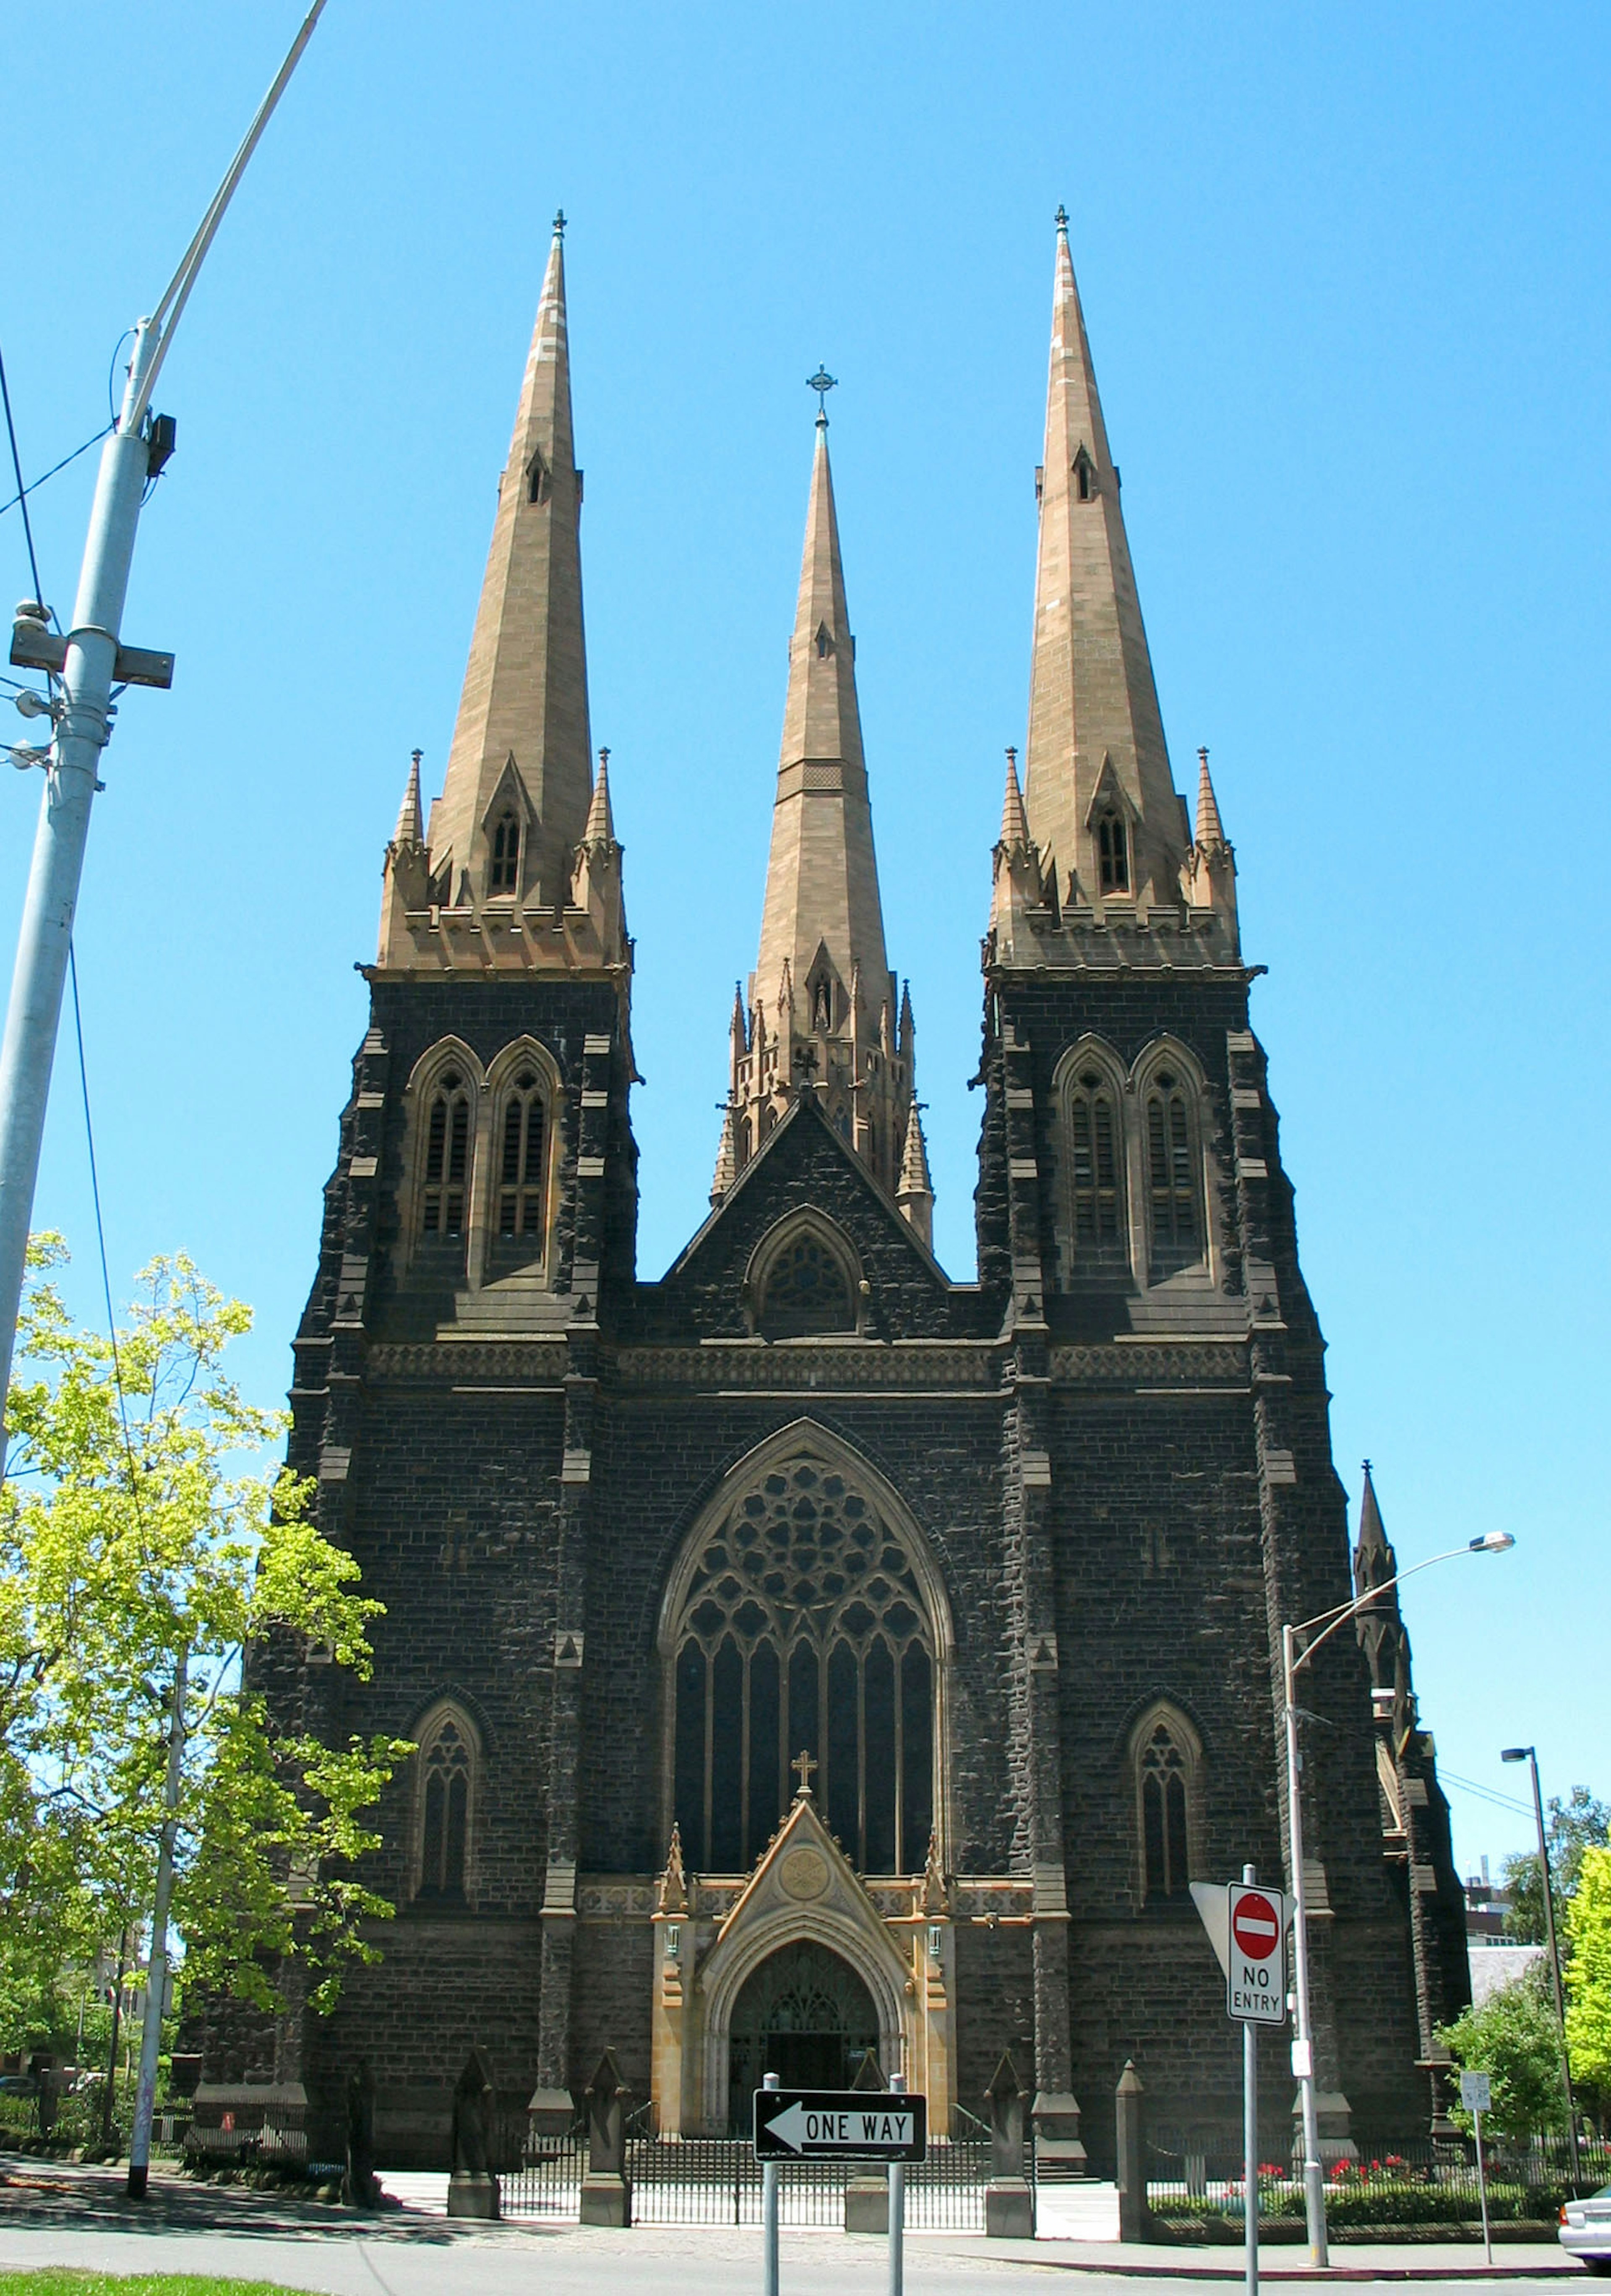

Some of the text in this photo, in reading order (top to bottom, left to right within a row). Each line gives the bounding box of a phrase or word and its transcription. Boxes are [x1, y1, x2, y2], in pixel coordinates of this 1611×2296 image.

[1244, 1966, 1269, 1987] NO
[1235, 1991, 1279, 2011] ENTRY
[806, 2114, 907, 2140] ONE WAY
